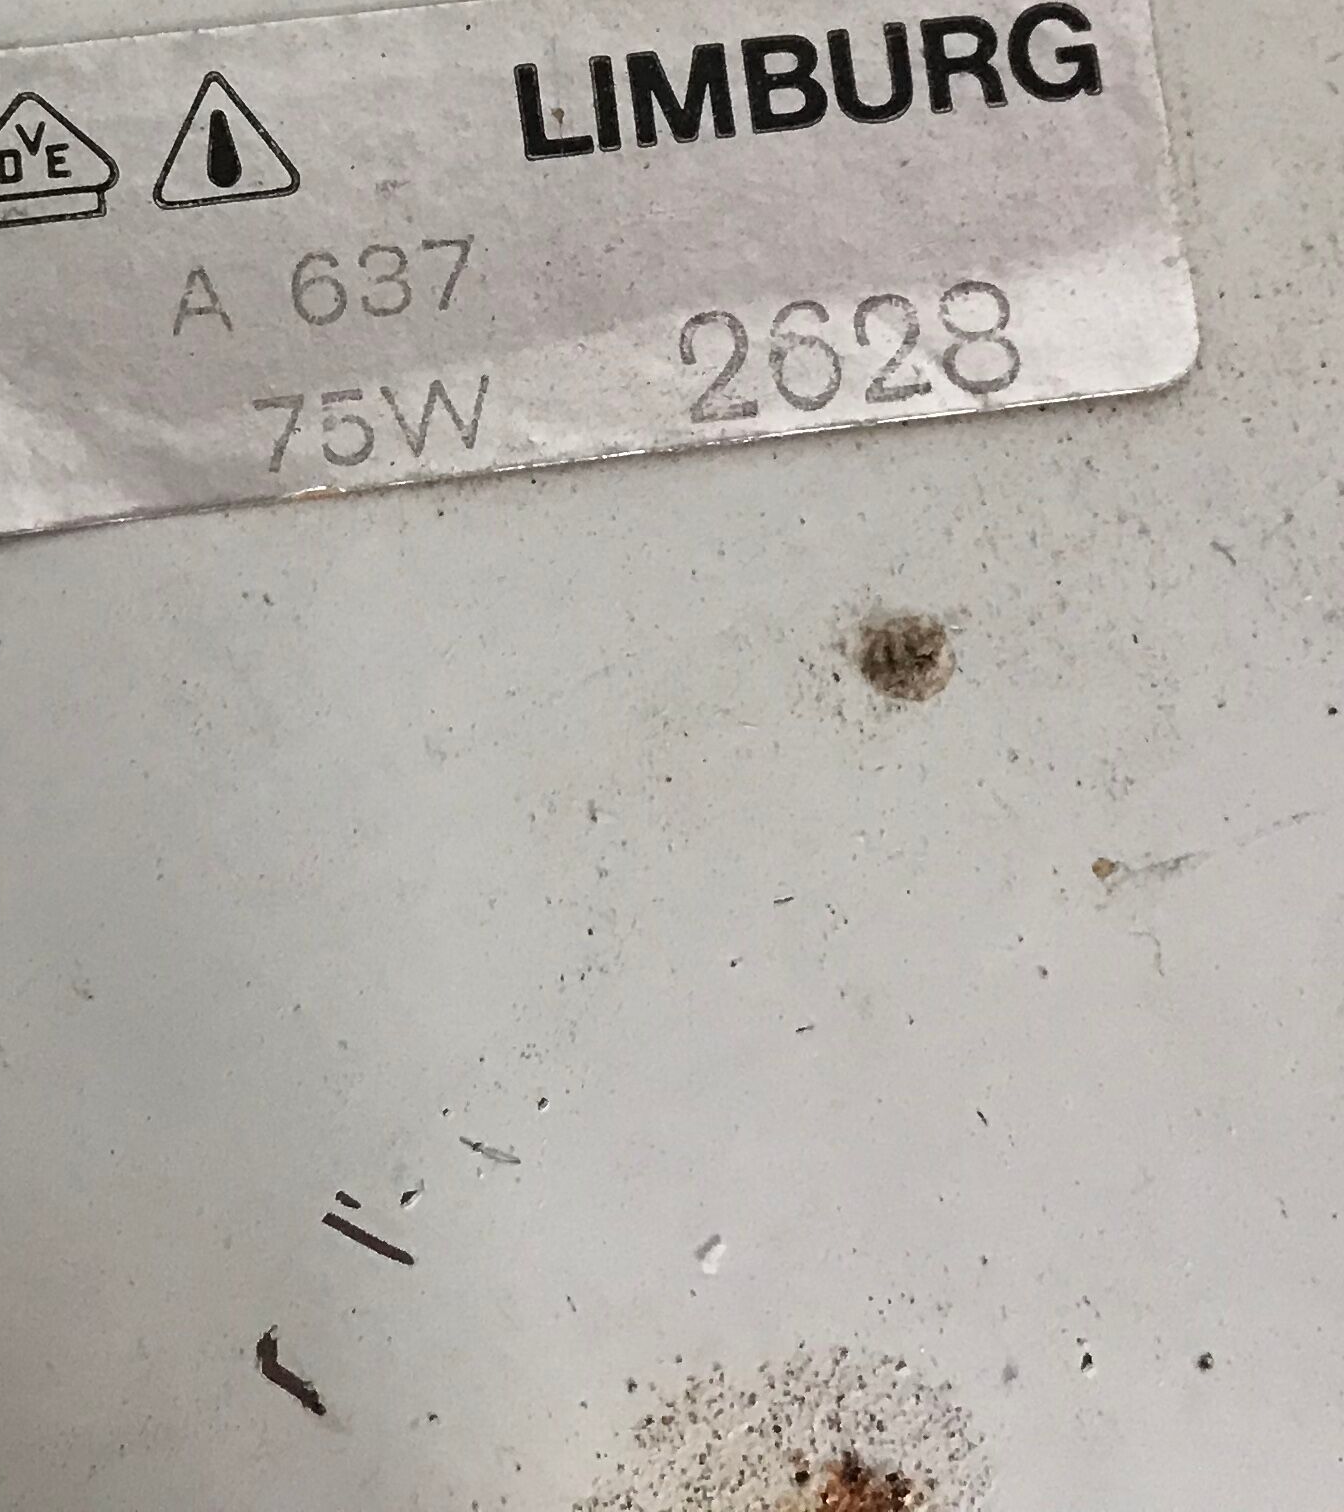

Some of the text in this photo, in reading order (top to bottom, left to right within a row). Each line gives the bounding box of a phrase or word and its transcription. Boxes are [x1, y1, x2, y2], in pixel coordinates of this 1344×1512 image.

[513, 3, 1104, 160] LIMBURG
[170, 235, 476, 339] A 637
[678, 278, 1024, 426] 2628
[252, 373, 492, 475] 75W
